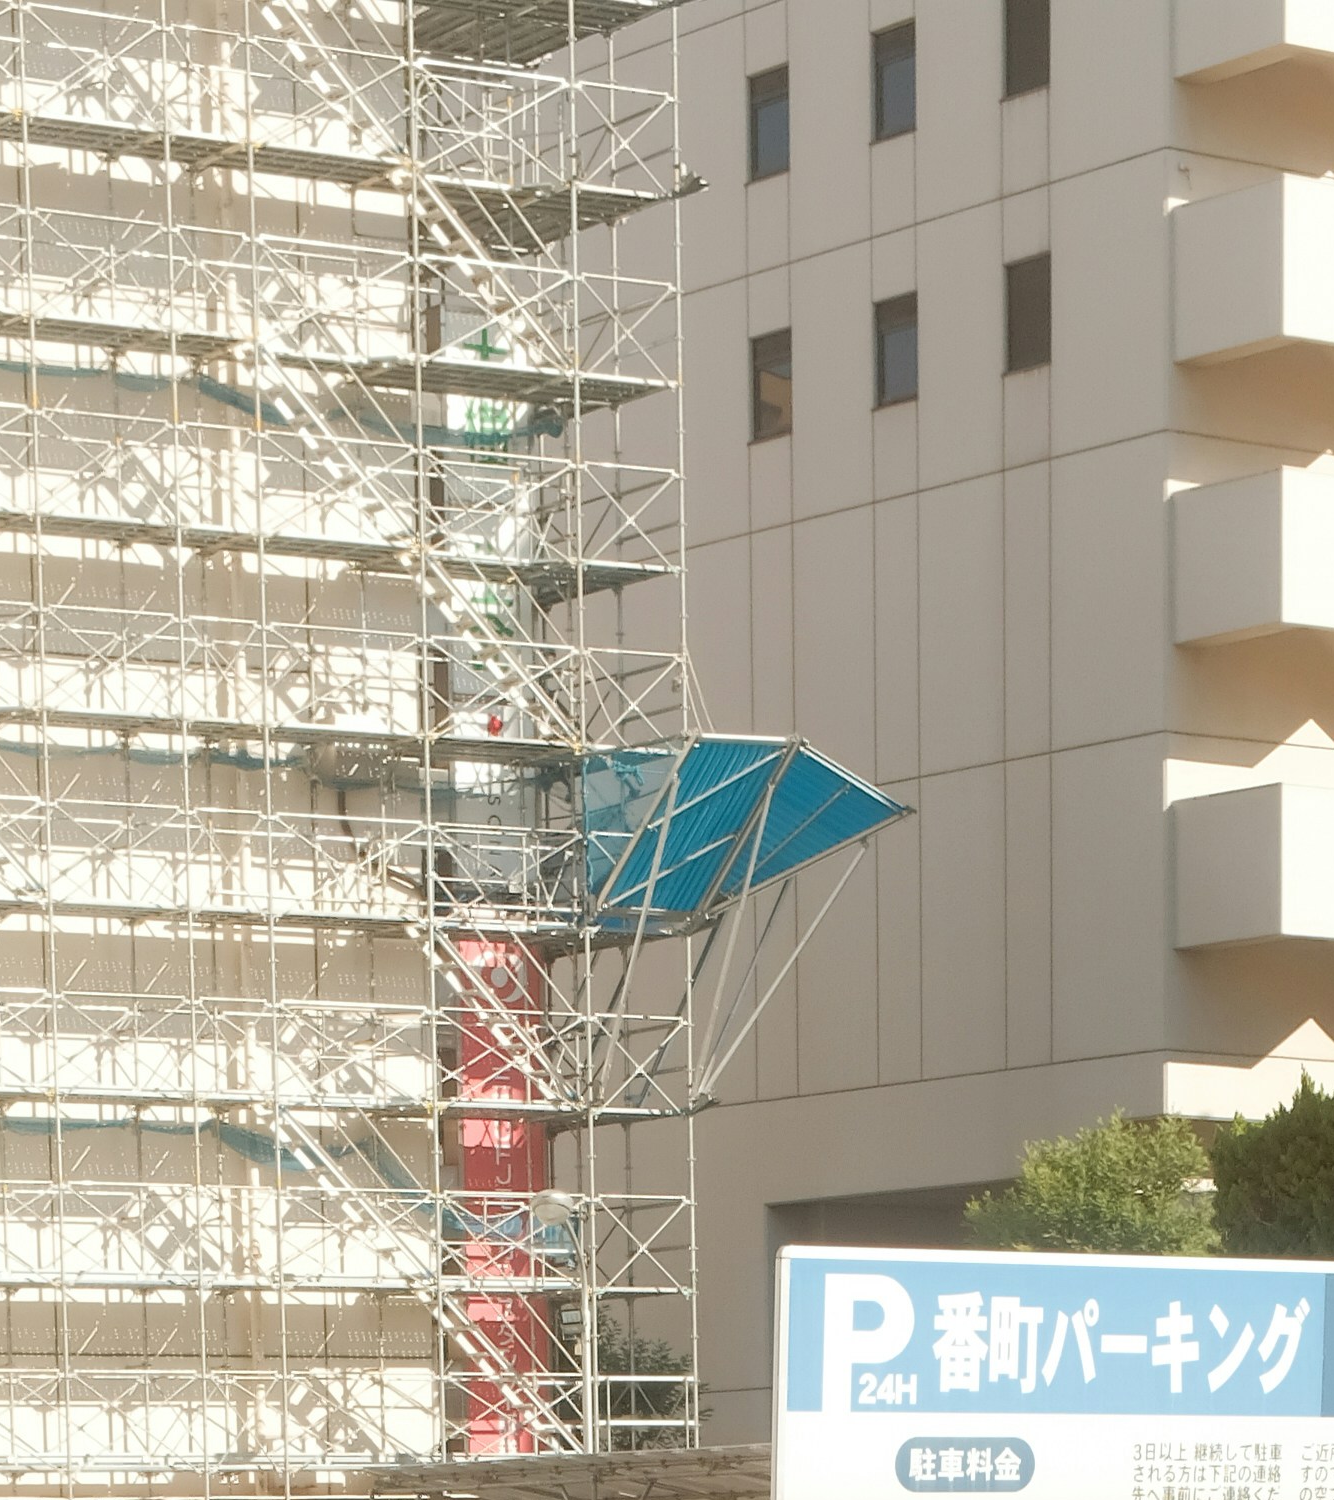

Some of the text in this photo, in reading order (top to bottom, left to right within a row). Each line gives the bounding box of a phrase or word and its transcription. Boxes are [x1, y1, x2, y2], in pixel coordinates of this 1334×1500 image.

[822, 1273, 915, 1411] P
[932, 1291, 1310, 1394] 番町パーキング
[858, 1373, 918, 1405] 24H
[908, 1446, 1022, 1482] 駐車料金
[1133, 1464, 1282, 1483] される方は下記の連絡
